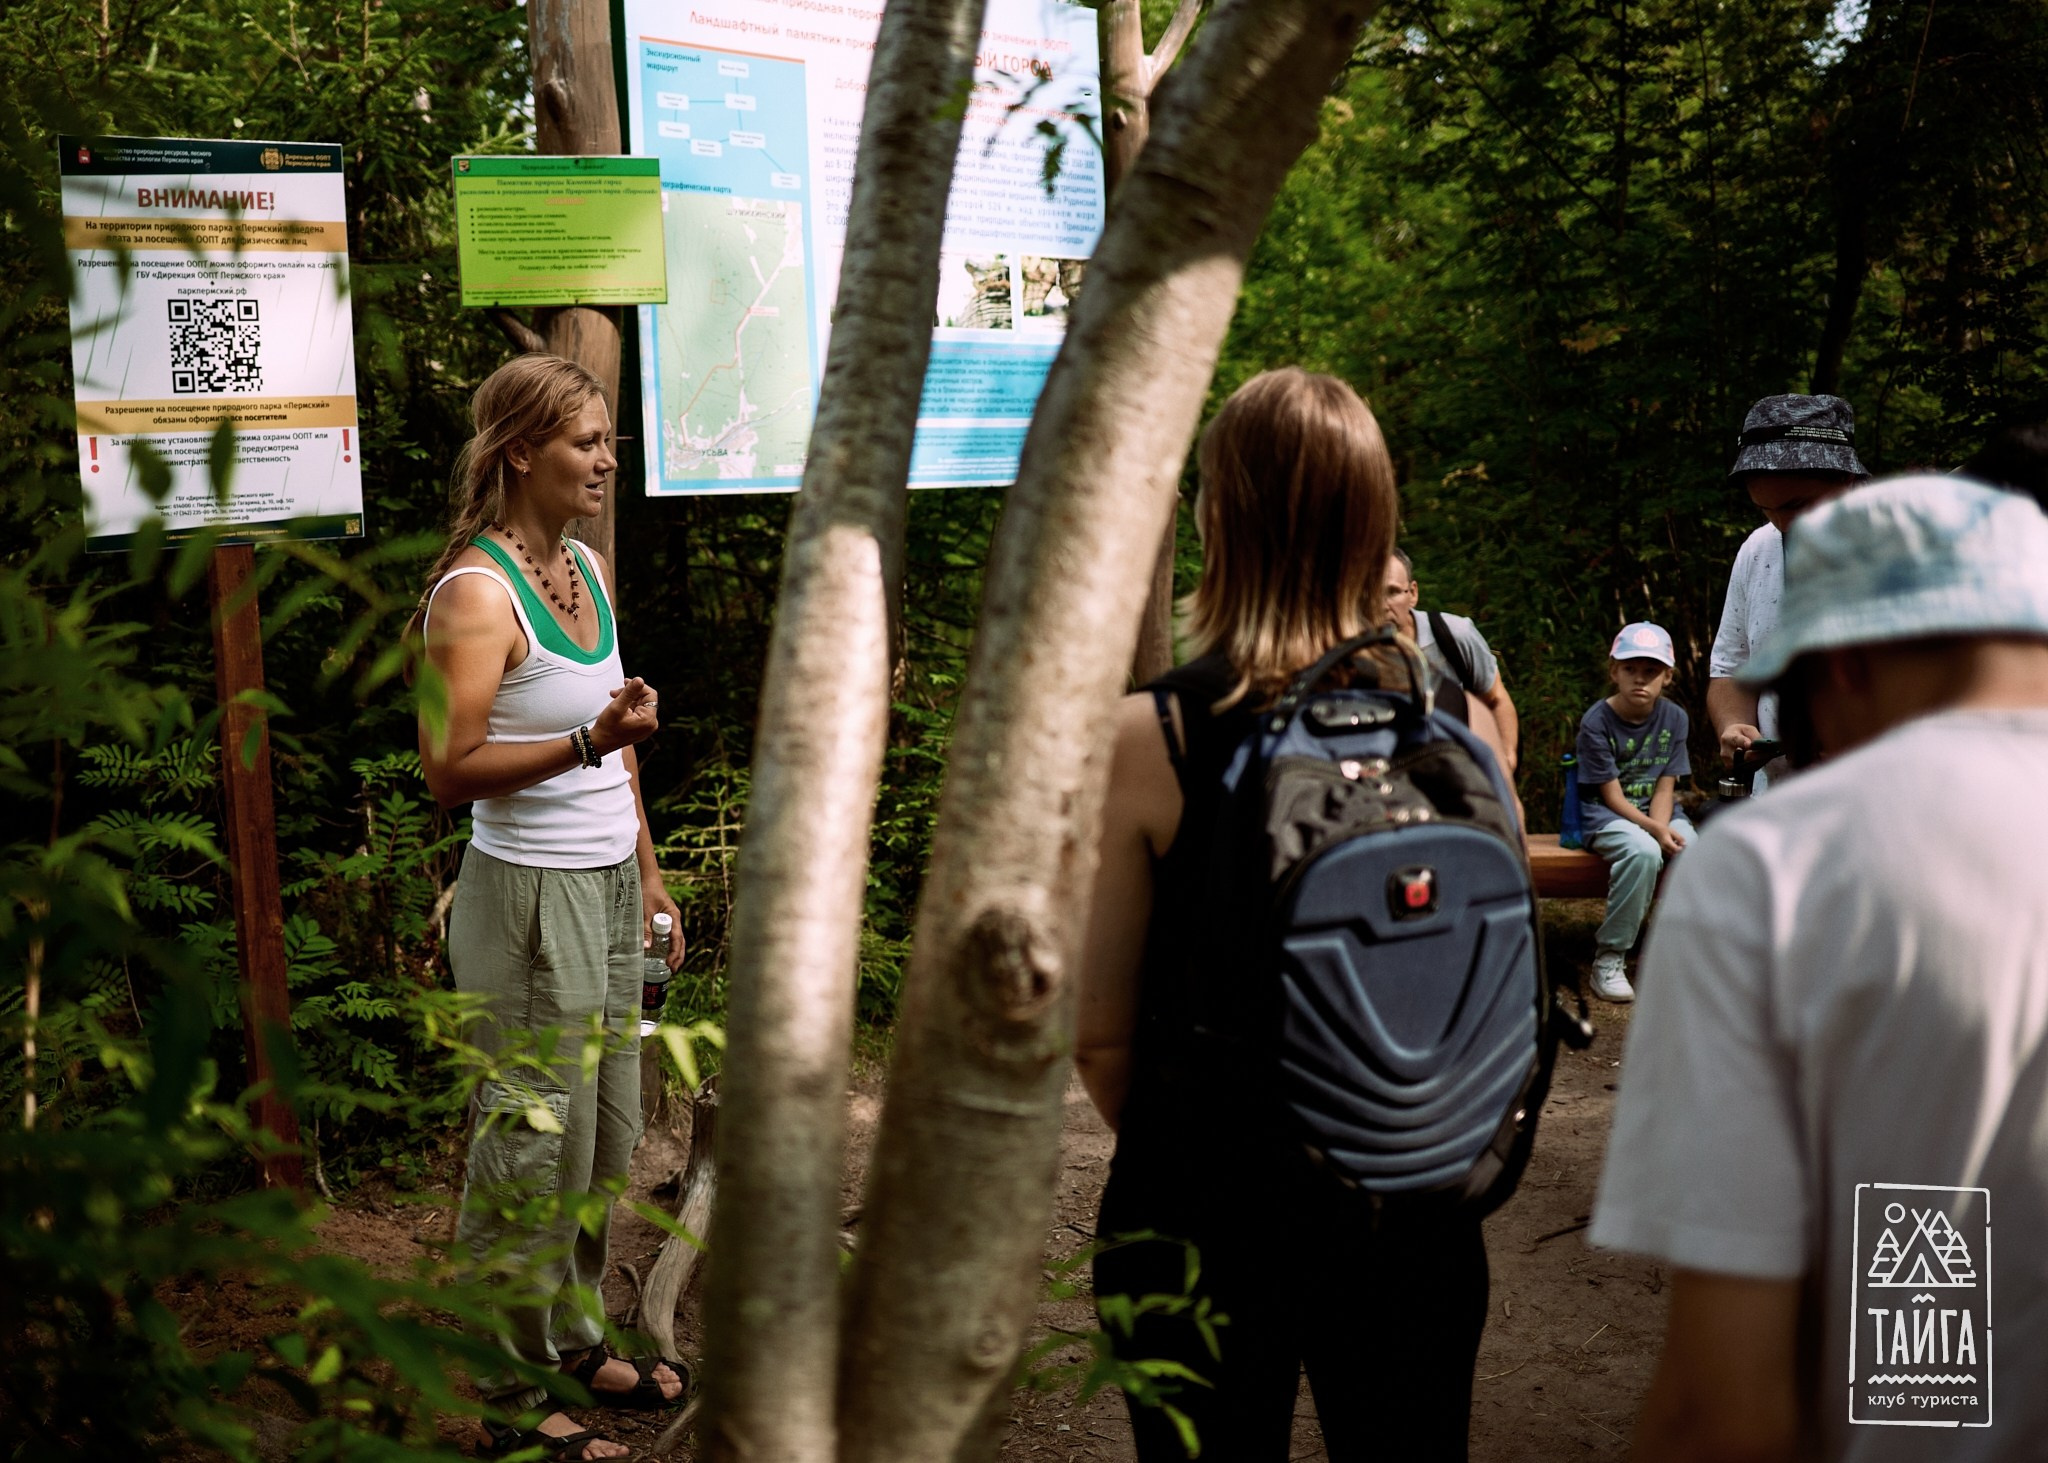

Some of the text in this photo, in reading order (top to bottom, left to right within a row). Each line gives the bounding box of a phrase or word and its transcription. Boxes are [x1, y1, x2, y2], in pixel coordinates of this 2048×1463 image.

[690, 11, 878, 52] Ландшафтный памятник приро
[646, 48, 701, 63] Экскурсионный
[646, 63, 679, 74] маршрут
[1003, 55, 1054, 82] ГОРОД
[137, 188, 275, 211] ВНИМАНИЕ!
[85, 221, 97, 230] На
[100, 222, 152, 232] территории
[154, 223, 206, 233] природного
[208, 225, 233, 233] парка
[196, 235, 219, 244] ООПТ
[78, 259, 124, 269] Разрешен
[141, 261, 185, 269] посещение
[187, 260, 208, 268] ООПТ
[239, 260, 275, 270] оформить
[278, 260, 305, 268] онлайн
[318, 260, 337, 269] сайте
[137, 271, 150, 279] ГБУ
[152, 271, 195, 280] «Дирекция
[198, 271, 218, 279] ООПТ
[221, 272, 261, 281] Пермского
[178, 287, 247, 296] паркпермский.рф
[105, 406, 154, 416] Разрешение
[168, 405, 210, 414] посещение
[212, 403, 258, 412] природного
[260, 403, 282, 411] парка
[284, 400, 330, 409] «Пермский»
[153, 415, 187, 425] обязаны
[244, 413, 287, 422] посетители
[111, 438, 120, 446] За
[263, 433, 291, 442] охраны
[292, 432, 312, 440] ООПТ
[242, 444, 299, 453] предусмотрена
[701, 449, 728, 457] УСЬВА
